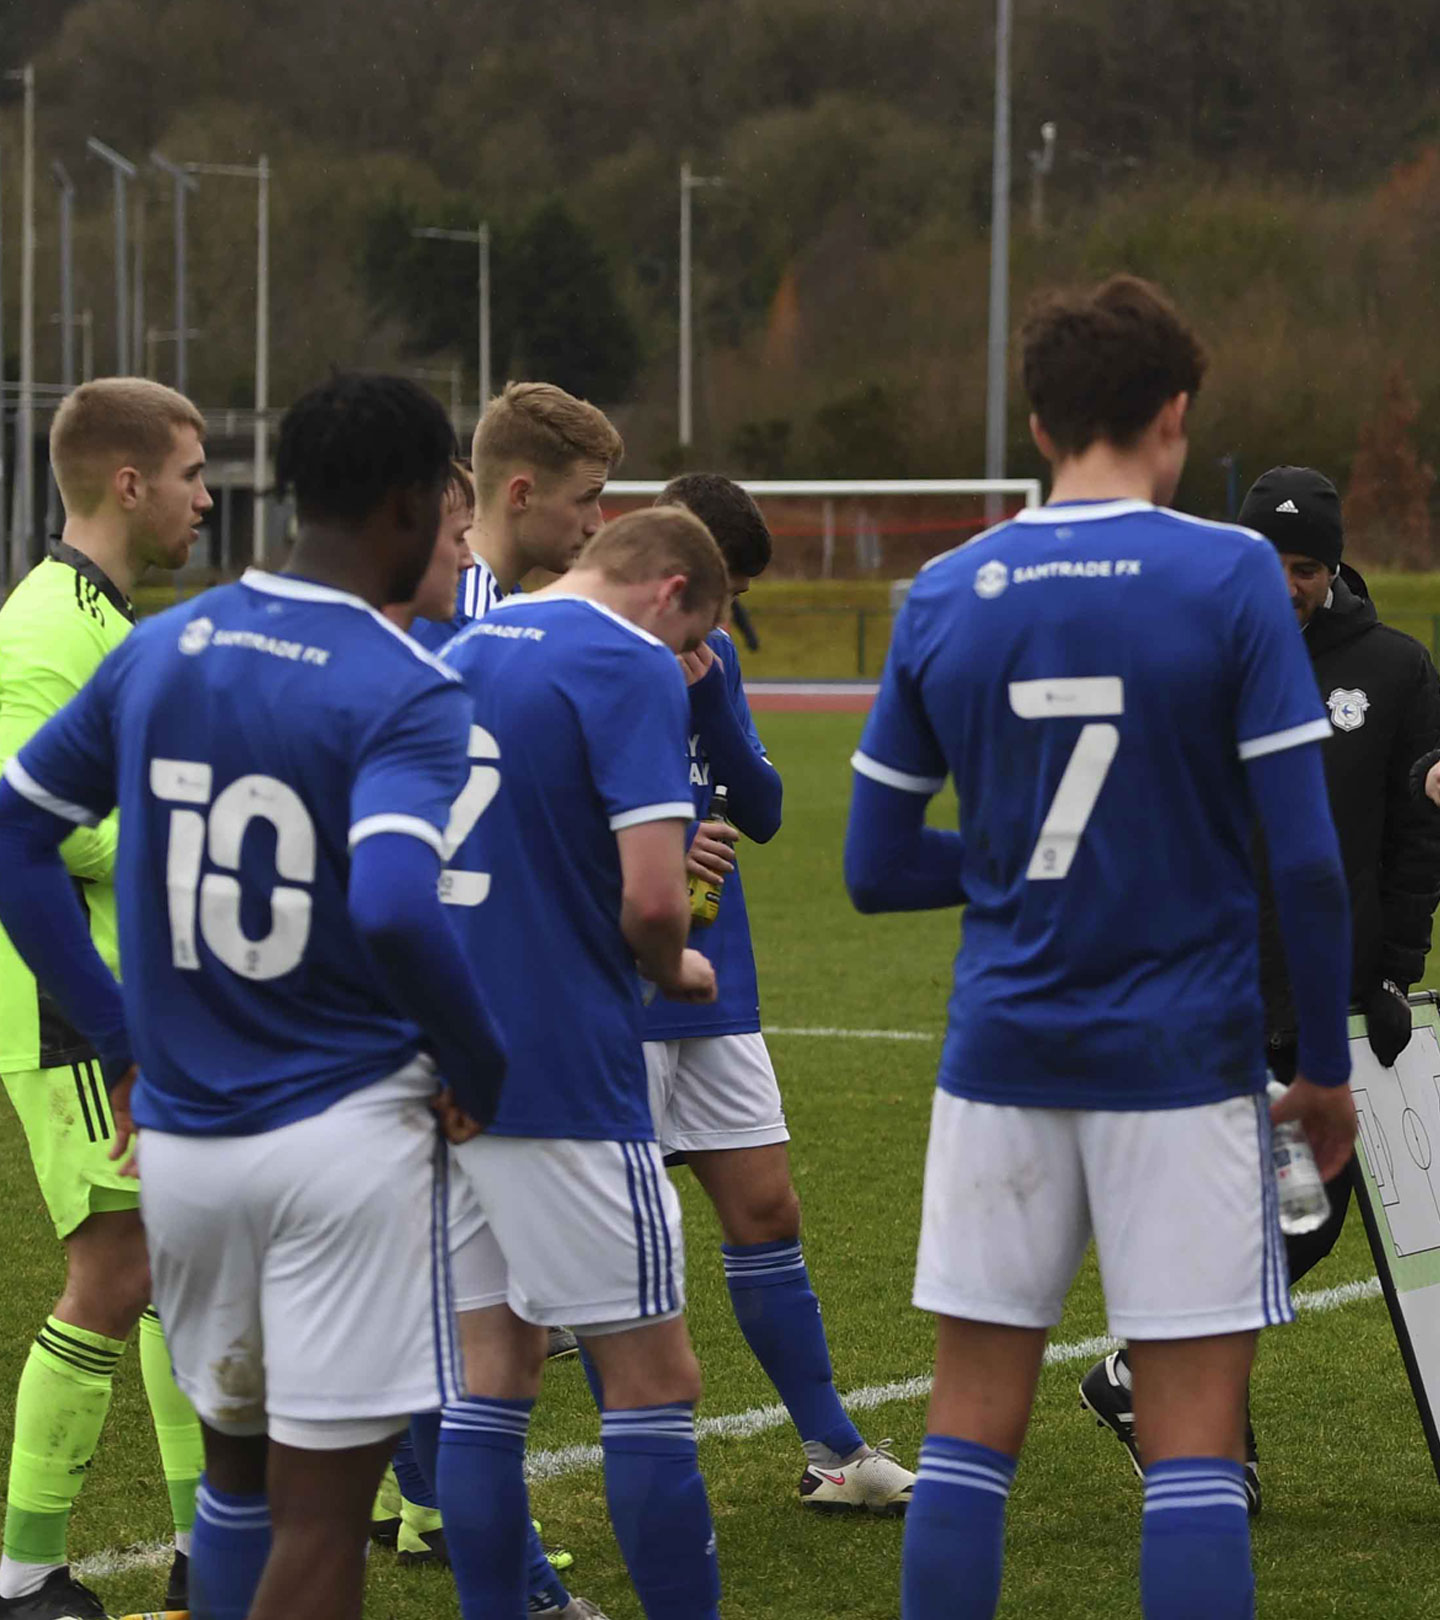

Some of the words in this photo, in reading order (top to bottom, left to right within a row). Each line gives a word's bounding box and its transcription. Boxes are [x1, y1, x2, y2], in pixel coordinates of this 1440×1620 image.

[1115, 560, 1141, 576] FX
[150, 758, 316, 981] 10
[438, 723, 501, 906] 2
[1008, 675, 1125, 880] 7
